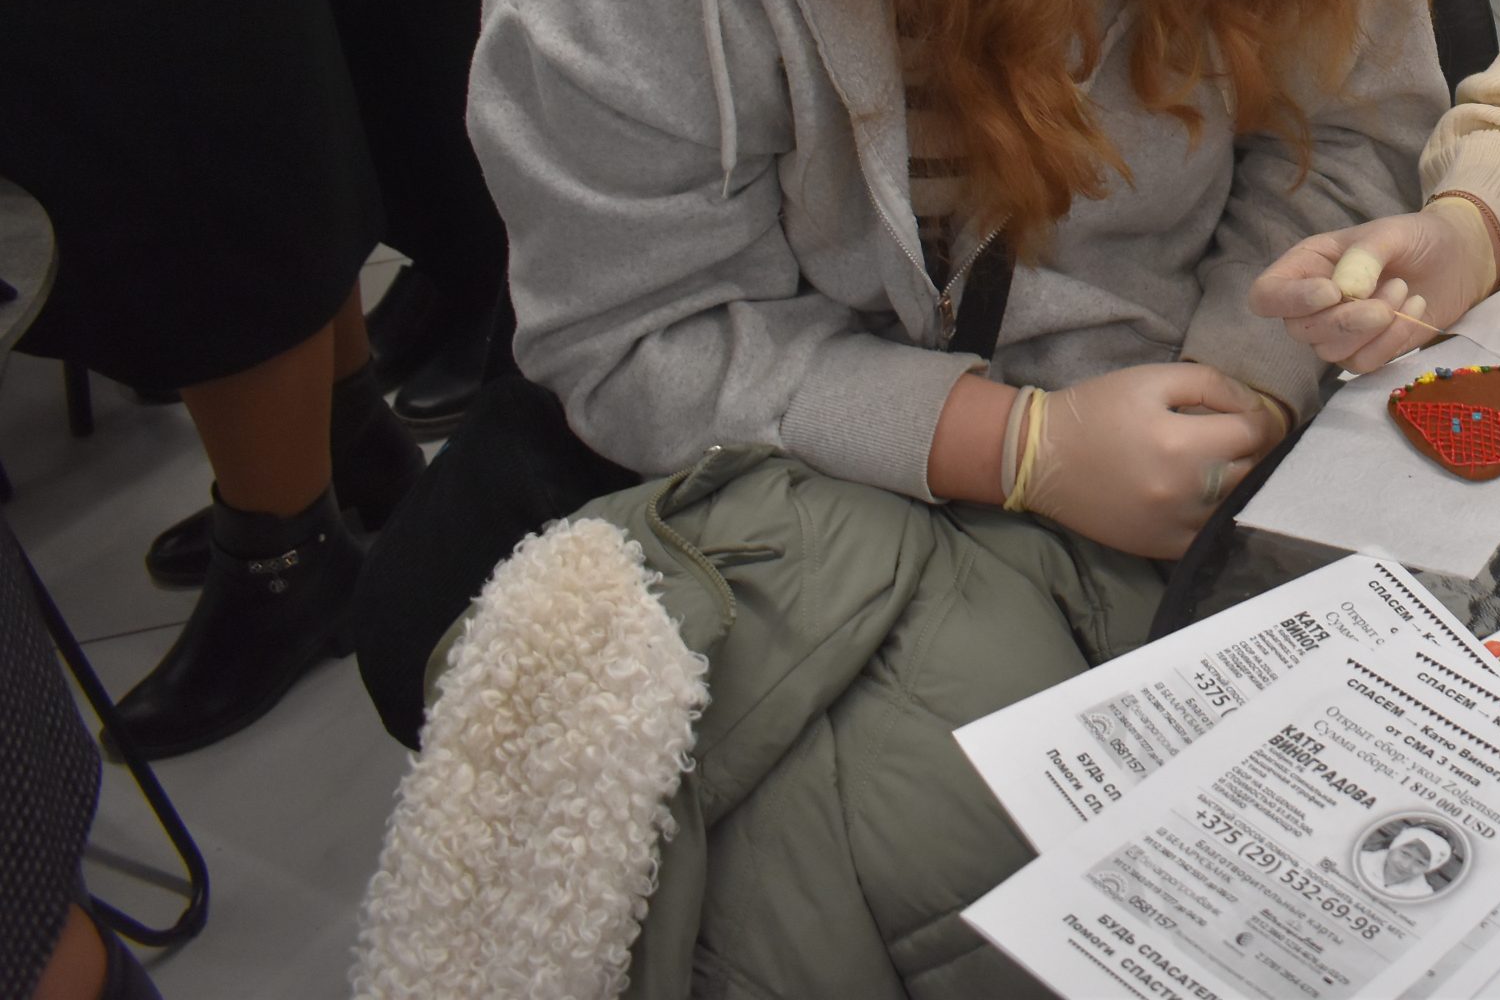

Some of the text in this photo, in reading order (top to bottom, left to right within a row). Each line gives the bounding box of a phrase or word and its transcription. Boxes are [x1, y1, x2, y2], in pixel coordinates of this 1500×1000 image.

[1341, 601, 1378, 639] Открыт
[1368, 580, 1414, 621] СПАСЕМ
[1294, 611, 1330, 641] КАТЯ
[1194, 672, 1231, 707] +375
[1416, 672, 1477, 710] СПАСЕМ
[1346, 678, 1405, 717] СПАСЕМ
[1420, 725, 1456, 751] Катю
[1110, 738, 1146, 773] 0581157
[1280, 724, 1325, 755] КАТЯ
[1325, 706, 1375, 741] Открыт
[1405, 761, 1441, 785] укол
[1385, 725, 1481, 787] от СМА 3 типа
[1046, 749, 1104, 814] Помоги СП
[1077, 752, 1105, 783] БУДЬ
[1268, 734, 1377, 810] ВИНОГРАДОВА
[1313, 719, 1357, 752] Сумма
[1400, 775, 1410, 785] 1
[1409, 782, 1437, 800] 819
[1435, 798, 1463, 817] 000
[1462, 814, 1496, 839] USD
[1195, 839, 1307, 920] Благотворительные
[1306, 919, 1344, 945] карты
[1196, 810, 1243, 845] +375
[1237, 841, 1282, 875] (29)
[1279, 869, 1381, 940] 532-69-98
[1097, 914, 1136, 945] БУДЬ
[1129, 895, 1177, 929] 0581157
[1063, 914, 1115, 956] Помоги
